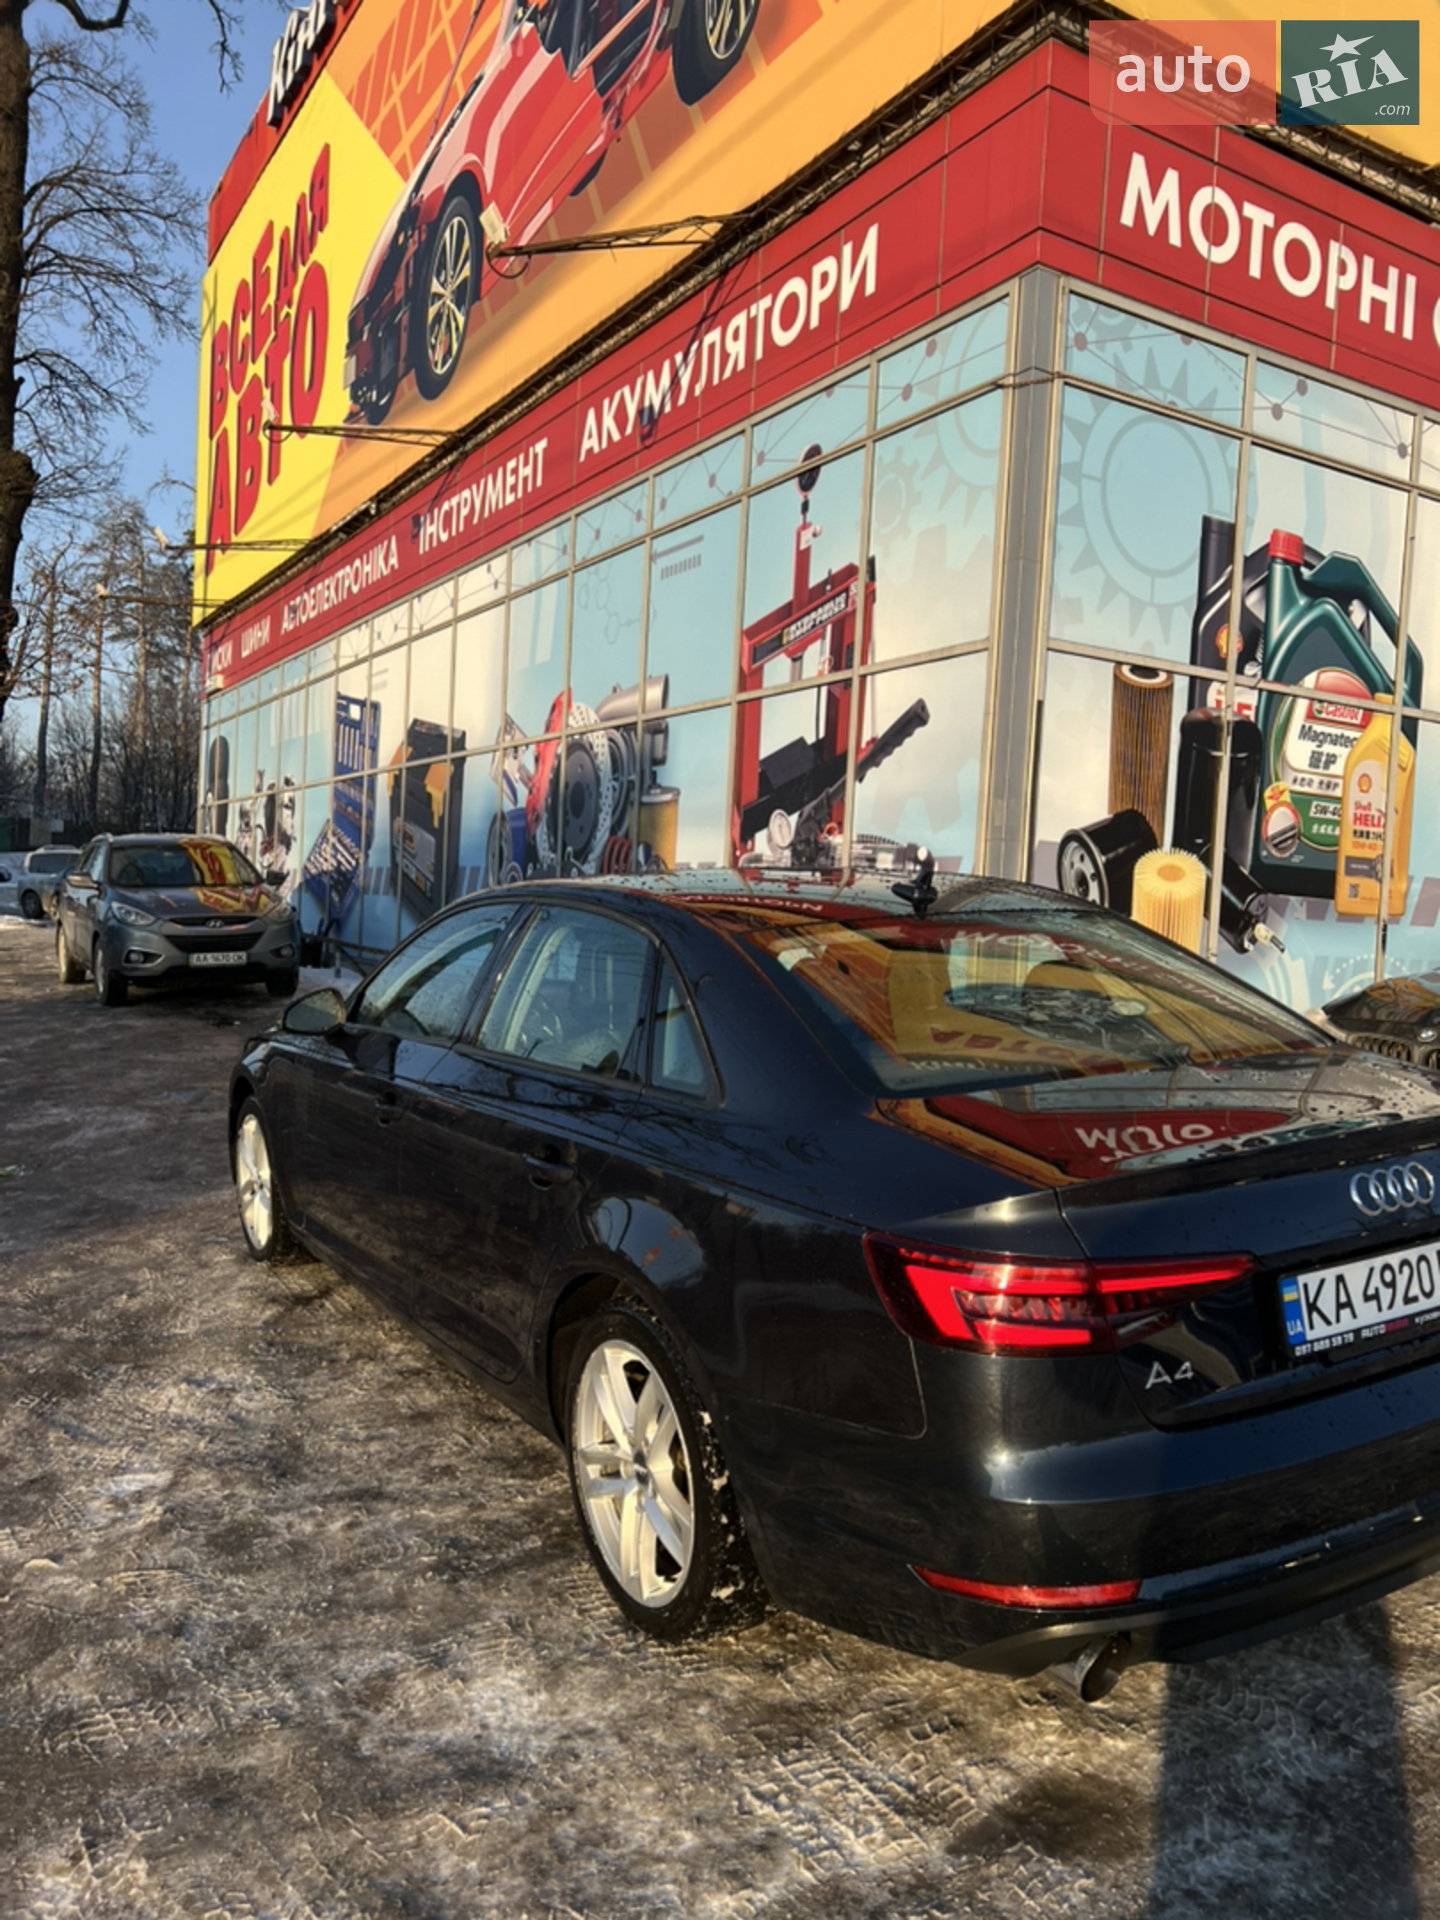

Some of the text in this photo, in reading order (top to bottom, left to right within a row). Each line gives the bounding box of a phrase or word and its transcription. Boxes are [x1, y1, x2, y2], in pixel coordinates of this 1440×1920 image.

[210, 219, 274, 441] ВСЕ
[1119, 152, 1417, 341] МОТОРНІ
[203, 259, 330, 577] АВТО
[418, 437, 549, 555] ІНСТРУМЕНТ
[579, 222, 879, 463] АКУМУЛЯТОРИ
[1145, 1361, 1194, 1390] A4
[1287, 1318, 1304, 1336] UA
[1302, 1273, 1358, 1331] KA
[1362, 1253, 1436, 1313] 4920
